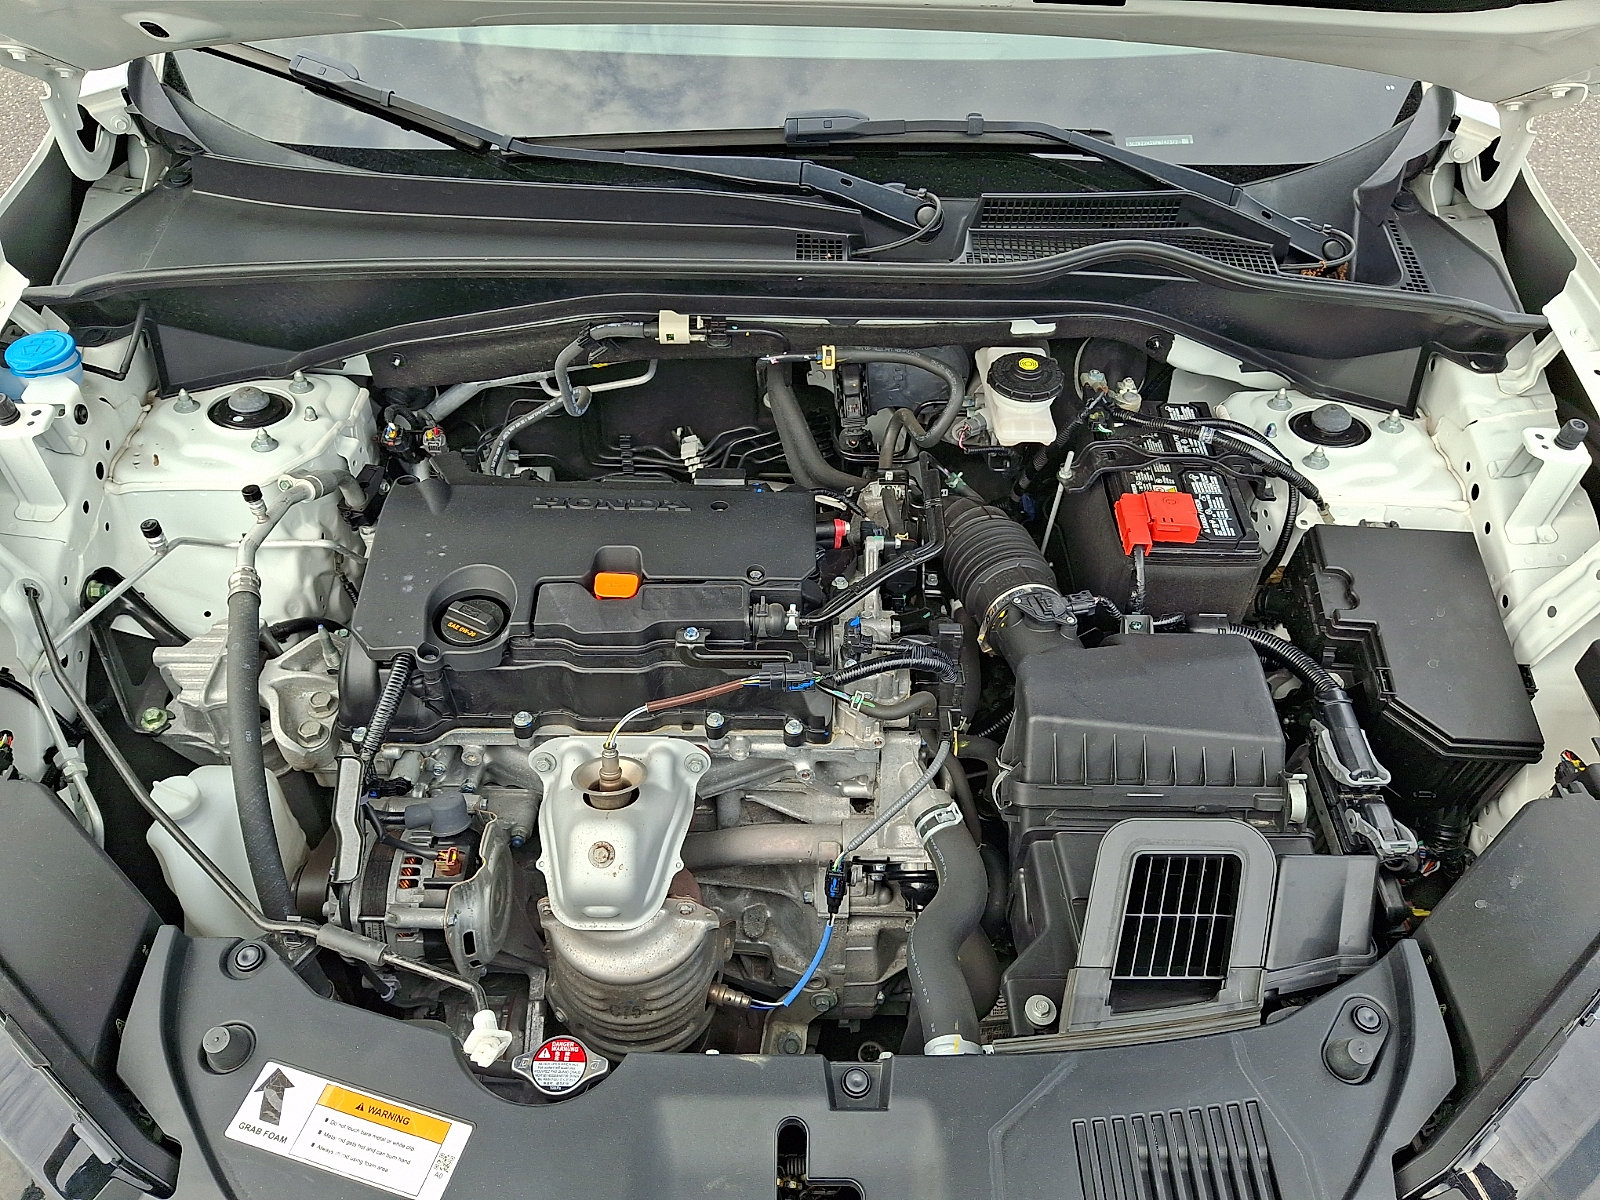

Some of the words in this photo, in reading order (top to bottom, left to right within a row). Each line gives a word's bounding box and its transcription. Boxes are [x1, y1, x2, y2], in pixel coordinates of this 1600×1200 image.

[532, 497, 692, 511] HONDA
[447, 621, 460, 631] SAE
[368, 1105, 410, 1125] WARNING
[238, 1122, 262, 1135] GRAB
[263, 1130, 288, 1144] FOAM
[373, 1133, 387, 1142] metal
[317, 1145, 334, 1154] Always
[350, 1156, 363, 1165] using
[366, 1146, 376, 1154] and
[386, 1153, 398, 1161] burn
[398, 1156, 411, 1165] hand
